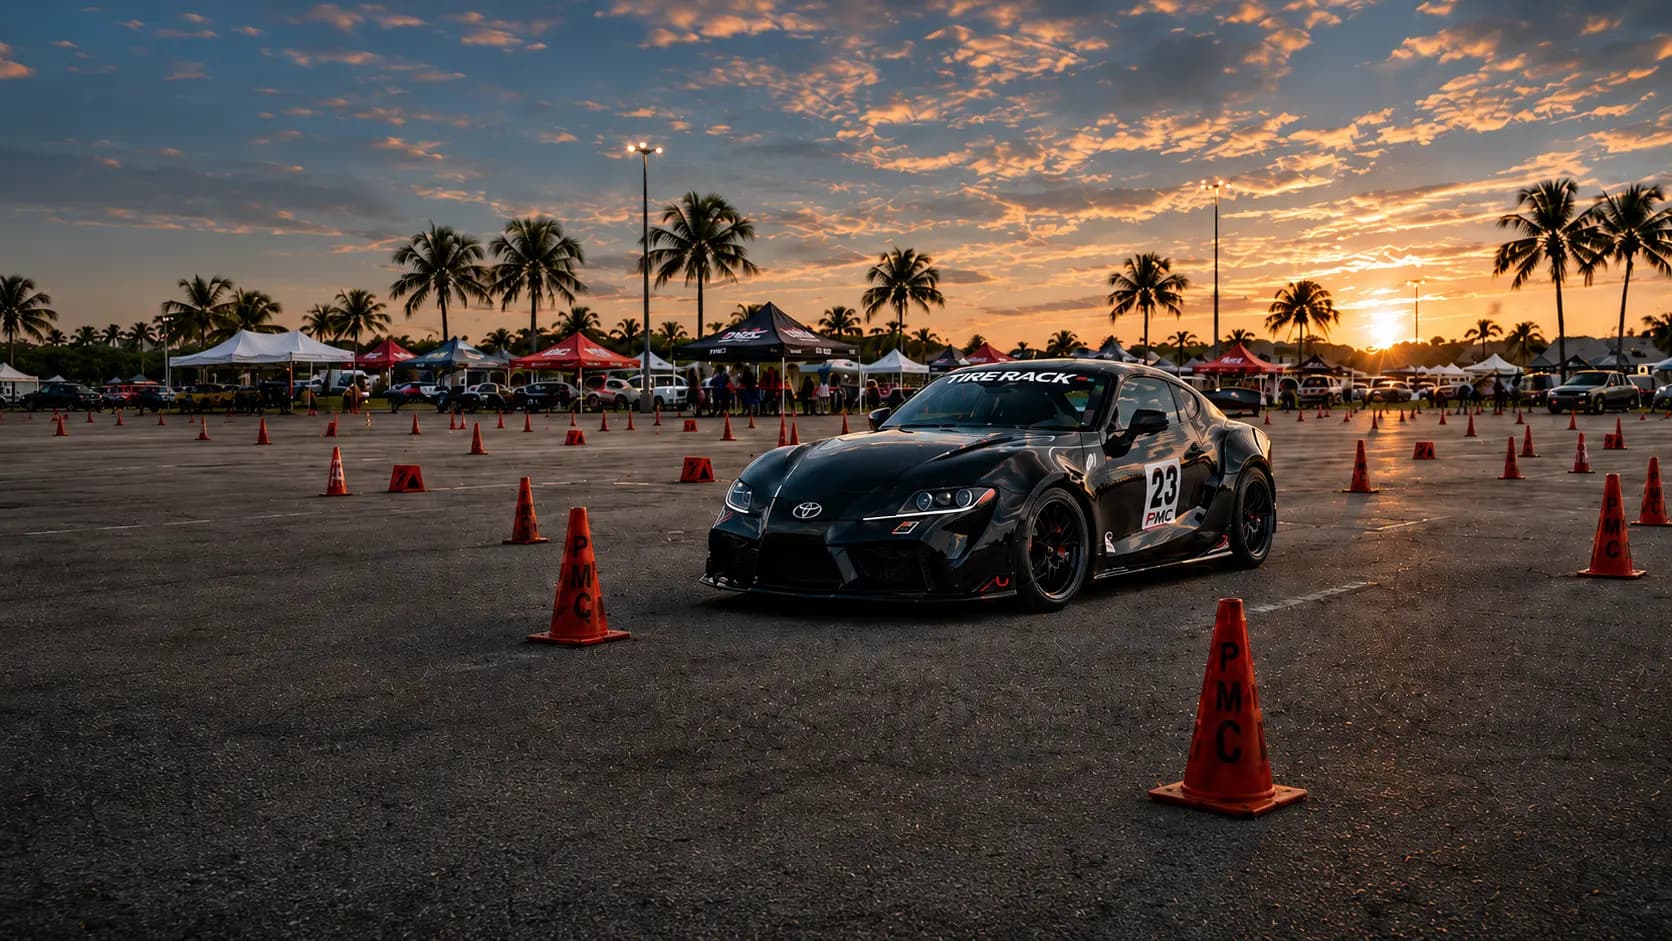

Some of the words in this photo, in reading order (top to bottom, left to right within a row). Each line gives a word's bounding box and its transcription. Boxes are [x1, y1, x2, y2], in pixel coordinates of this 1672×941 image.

[947, 371, 1003, 384] TIRE
[999, 371, 1077, 385] RACK
[1150, 464, 1178, 509] 23
[1145, 508, 1174, 527] PMC
[1604, 496, 1620, 559] PMC
[571, 535, 592, 620] PMC
[1216, 642, 1242, 764] PMC
